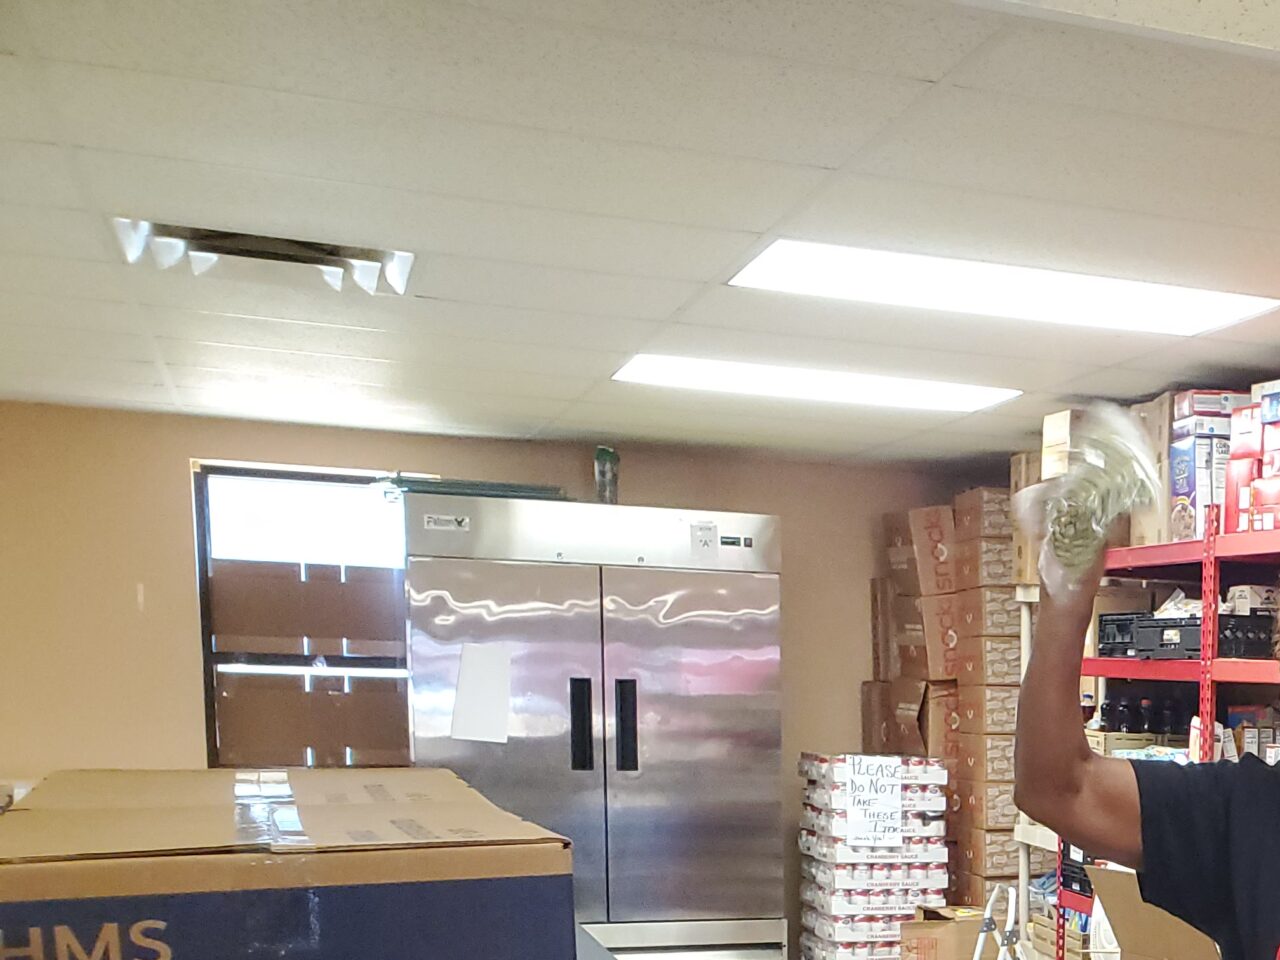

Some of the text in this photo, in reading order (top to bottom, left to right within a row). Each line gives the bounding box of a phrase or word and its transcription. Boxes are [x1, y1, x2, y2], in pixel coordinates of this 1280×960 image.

[850, 756, 902, 779] PLEASE
[850, 778, 899, 795] DO NOT
[850, 794, 878, 807] TAKE
[860, 808, 899, 820] THESE
